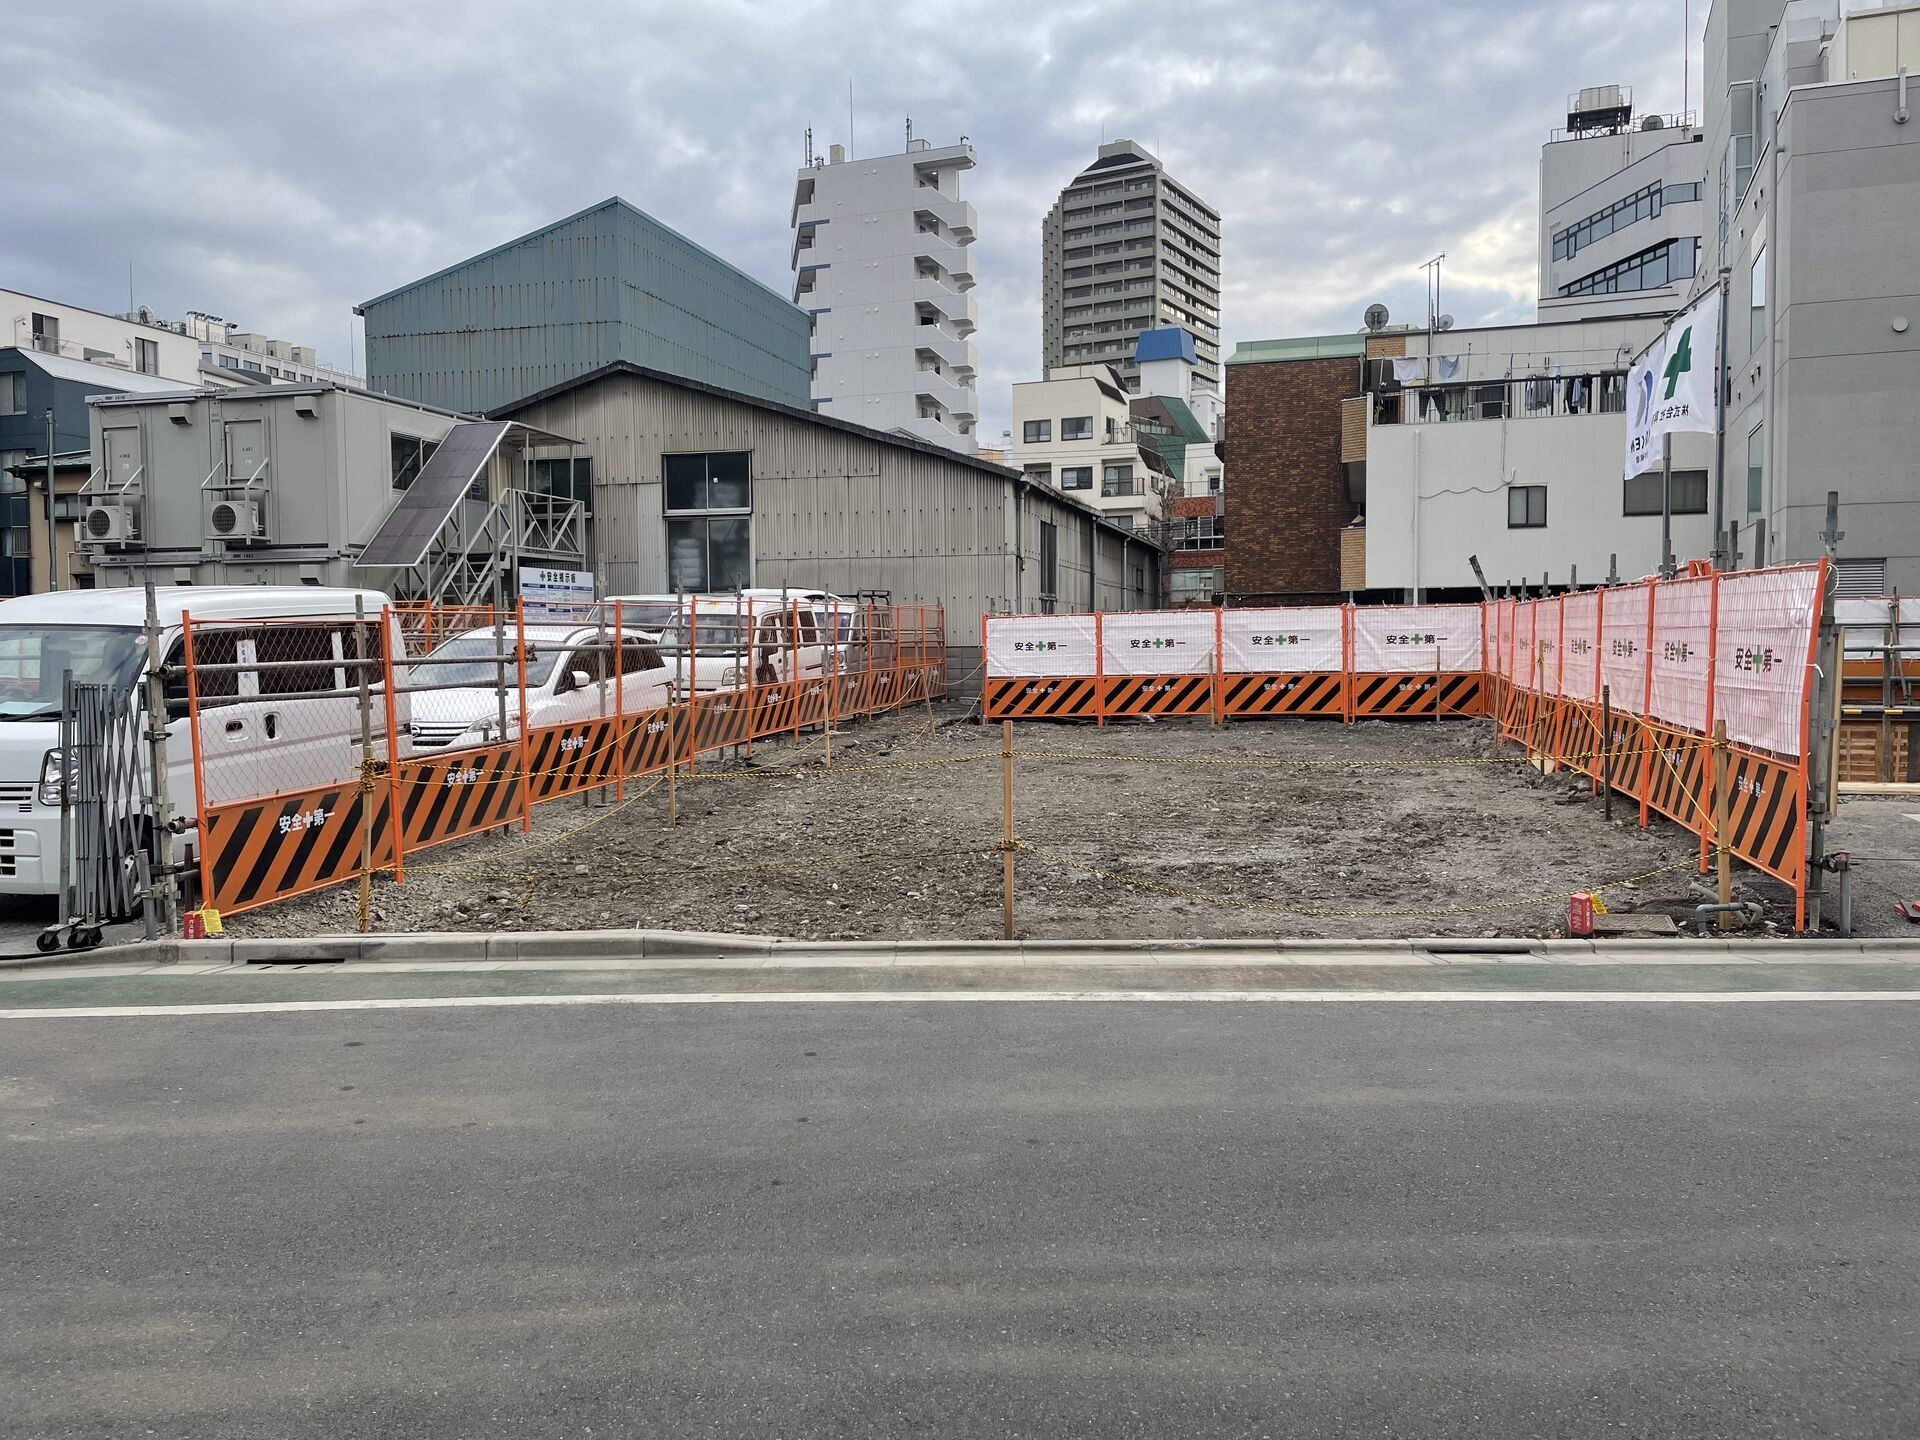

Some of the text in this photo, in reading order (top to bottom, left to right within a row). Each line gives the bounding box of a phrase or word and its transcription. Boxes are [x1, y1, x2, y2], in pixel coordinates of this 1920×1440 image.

[1014, 641, 1068, 651] 安全 第一
[1130, 638, 1186, 649] 安全 第一
[1251, 635, 1311, 645] 安全 第一
[1386, 634, 1448, 645] 安全 第一
[1612, 639, 1638, 657] 安全 第一
[1664, 642, 1694, 662] 安全 第一
[1734, 647, 1783, 672] 安全 第一
[660, 720, 669, 732] 第一
[561, 736, 589, 752] 安全 第一
[447, 770, 485, 788] 安全 第一
[279, 808, 336, 834] 安全 第一
